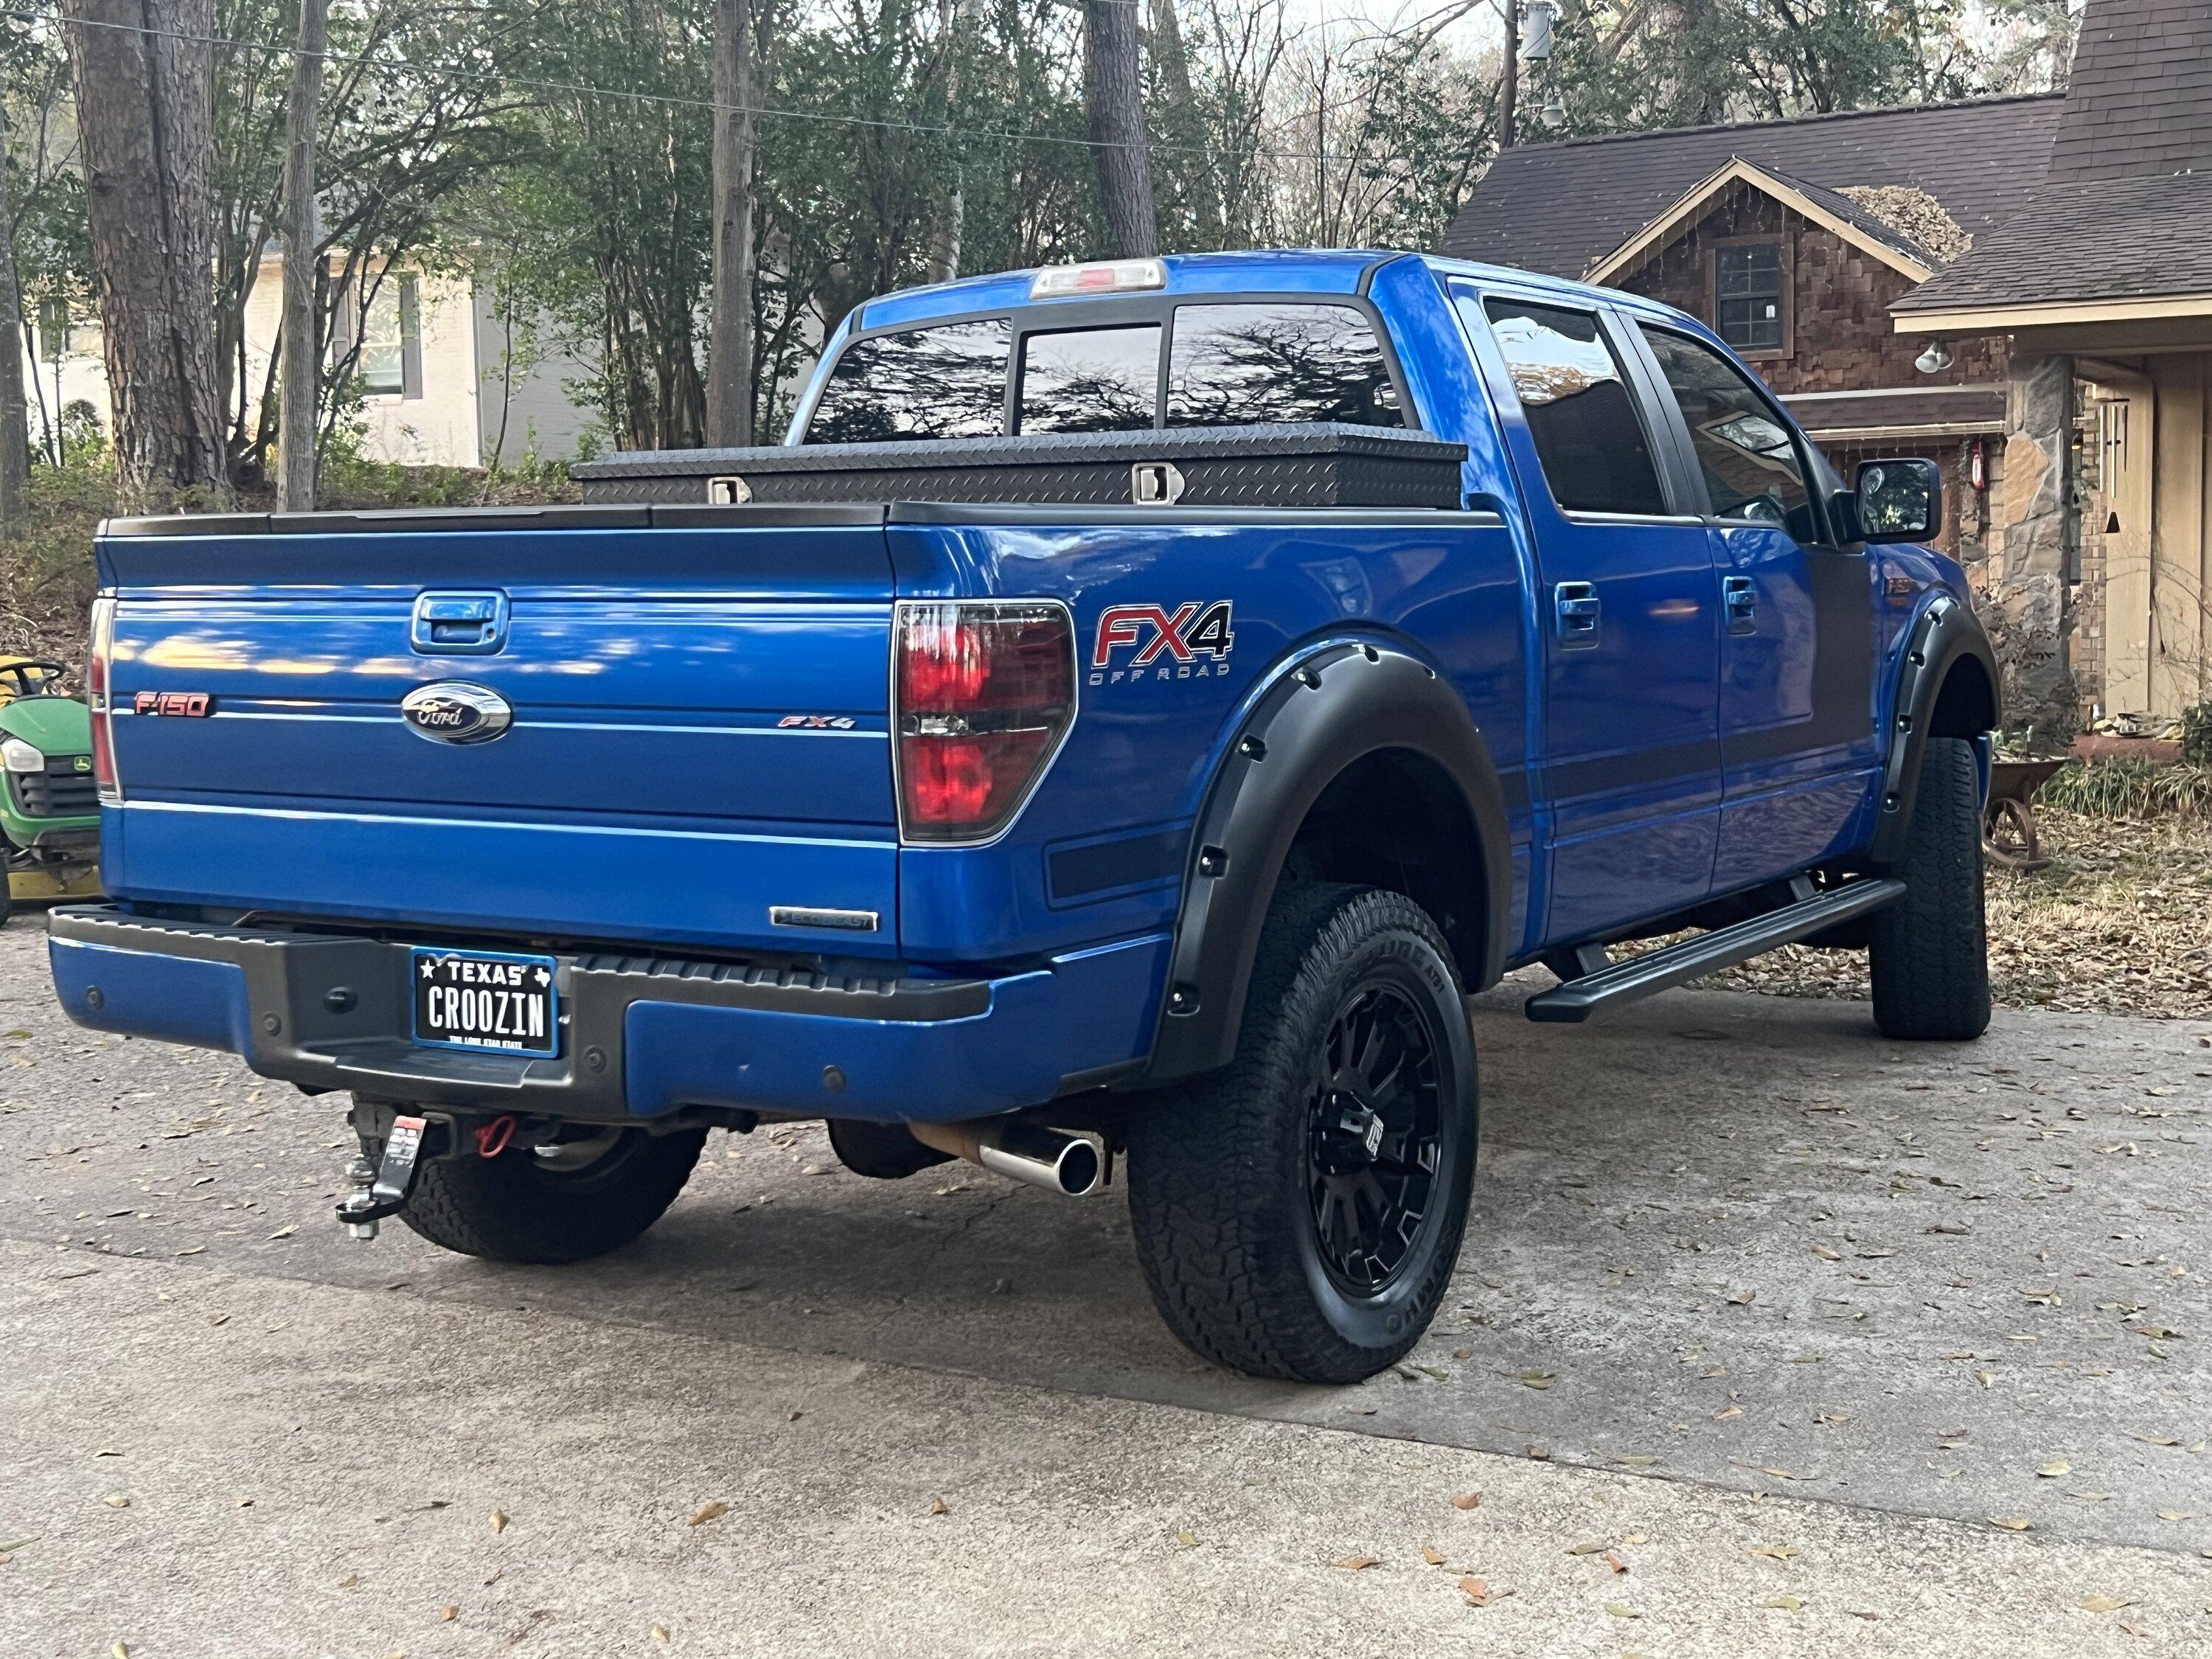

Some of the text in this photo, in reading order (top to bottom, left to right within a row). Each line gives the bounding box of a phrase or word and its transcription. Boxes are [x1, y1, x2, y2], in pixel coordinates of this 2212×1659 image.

[1091, 599, 1235, 669] FX4
[1089, 664, 1231, 686] OFF ROAD
[414, 698, 463, 726] Ford
[777, 715, 856, 728] FX4
[448, 961, 522, 987] TEXAS
[428, 985, 543, 1037] CROOZIN
